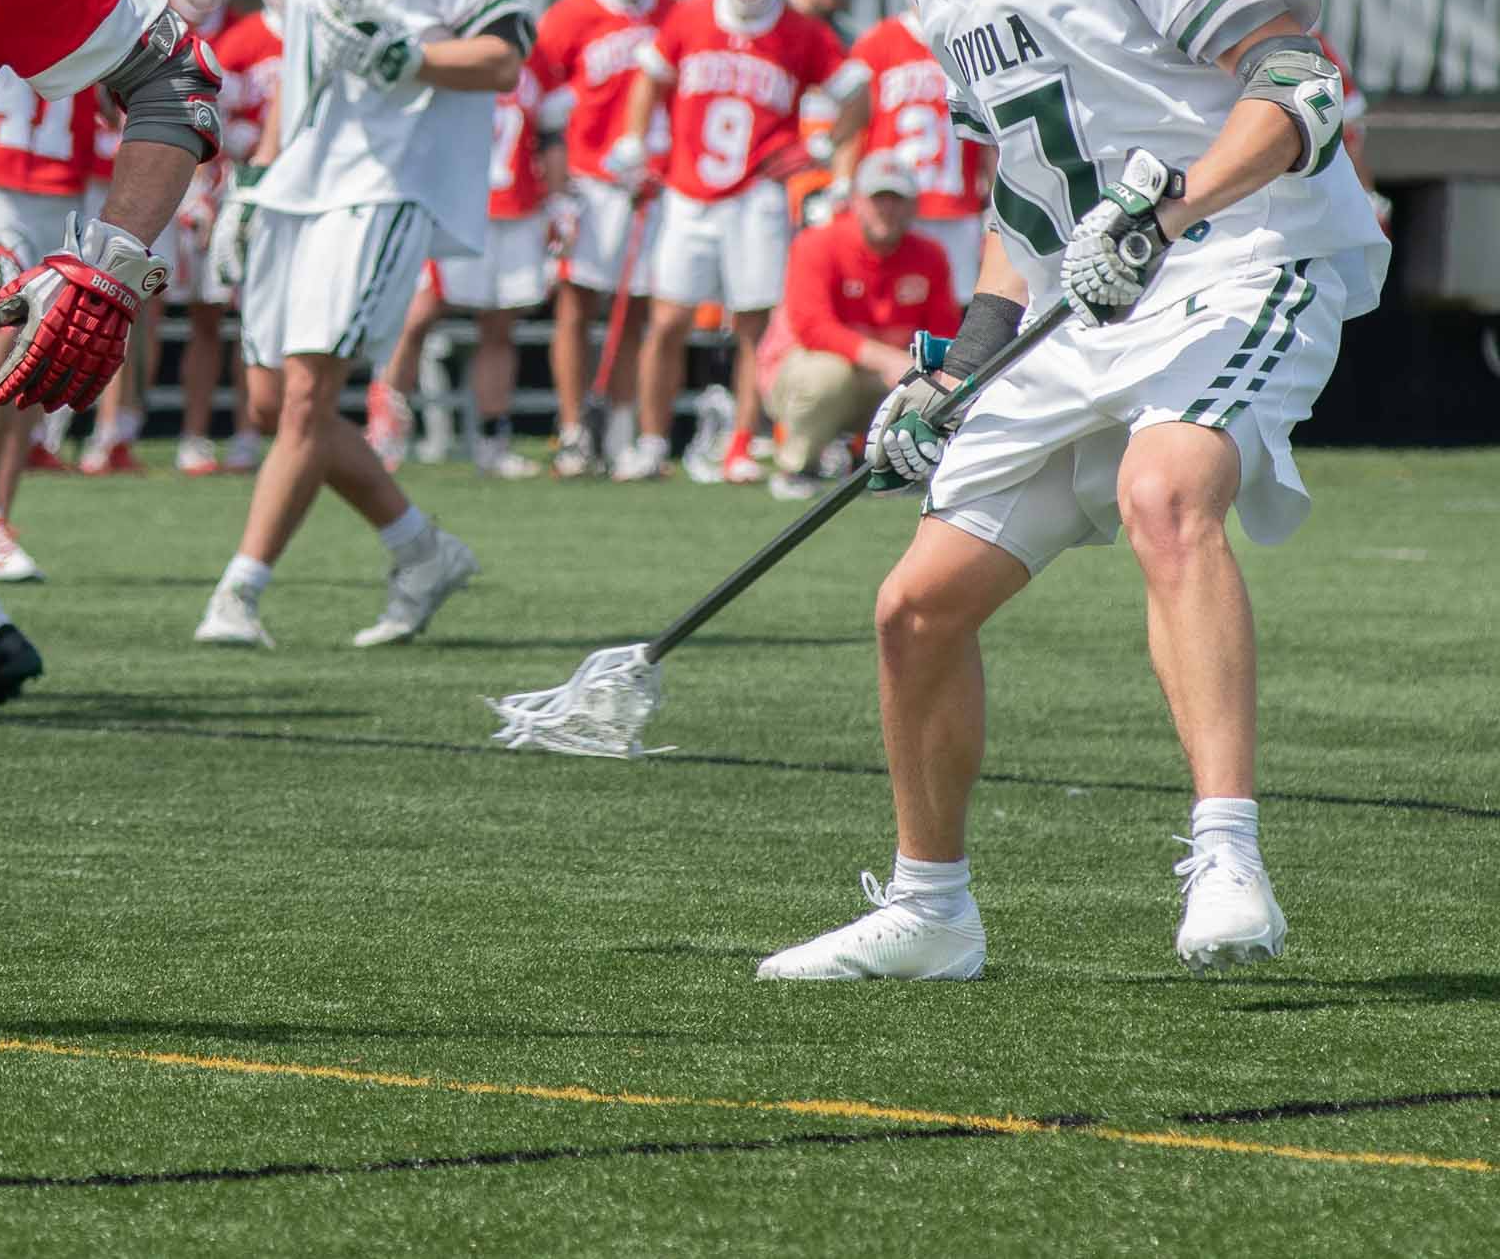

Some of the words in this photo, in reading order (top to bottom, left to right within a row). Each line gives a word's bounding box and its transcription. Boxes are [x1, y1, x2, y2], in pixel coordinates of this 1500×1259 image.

[945, 14, 1043, 87] OYOLA
[696, 95, 753, 188] 9
[91, 273, 135, 311] BOSTON
